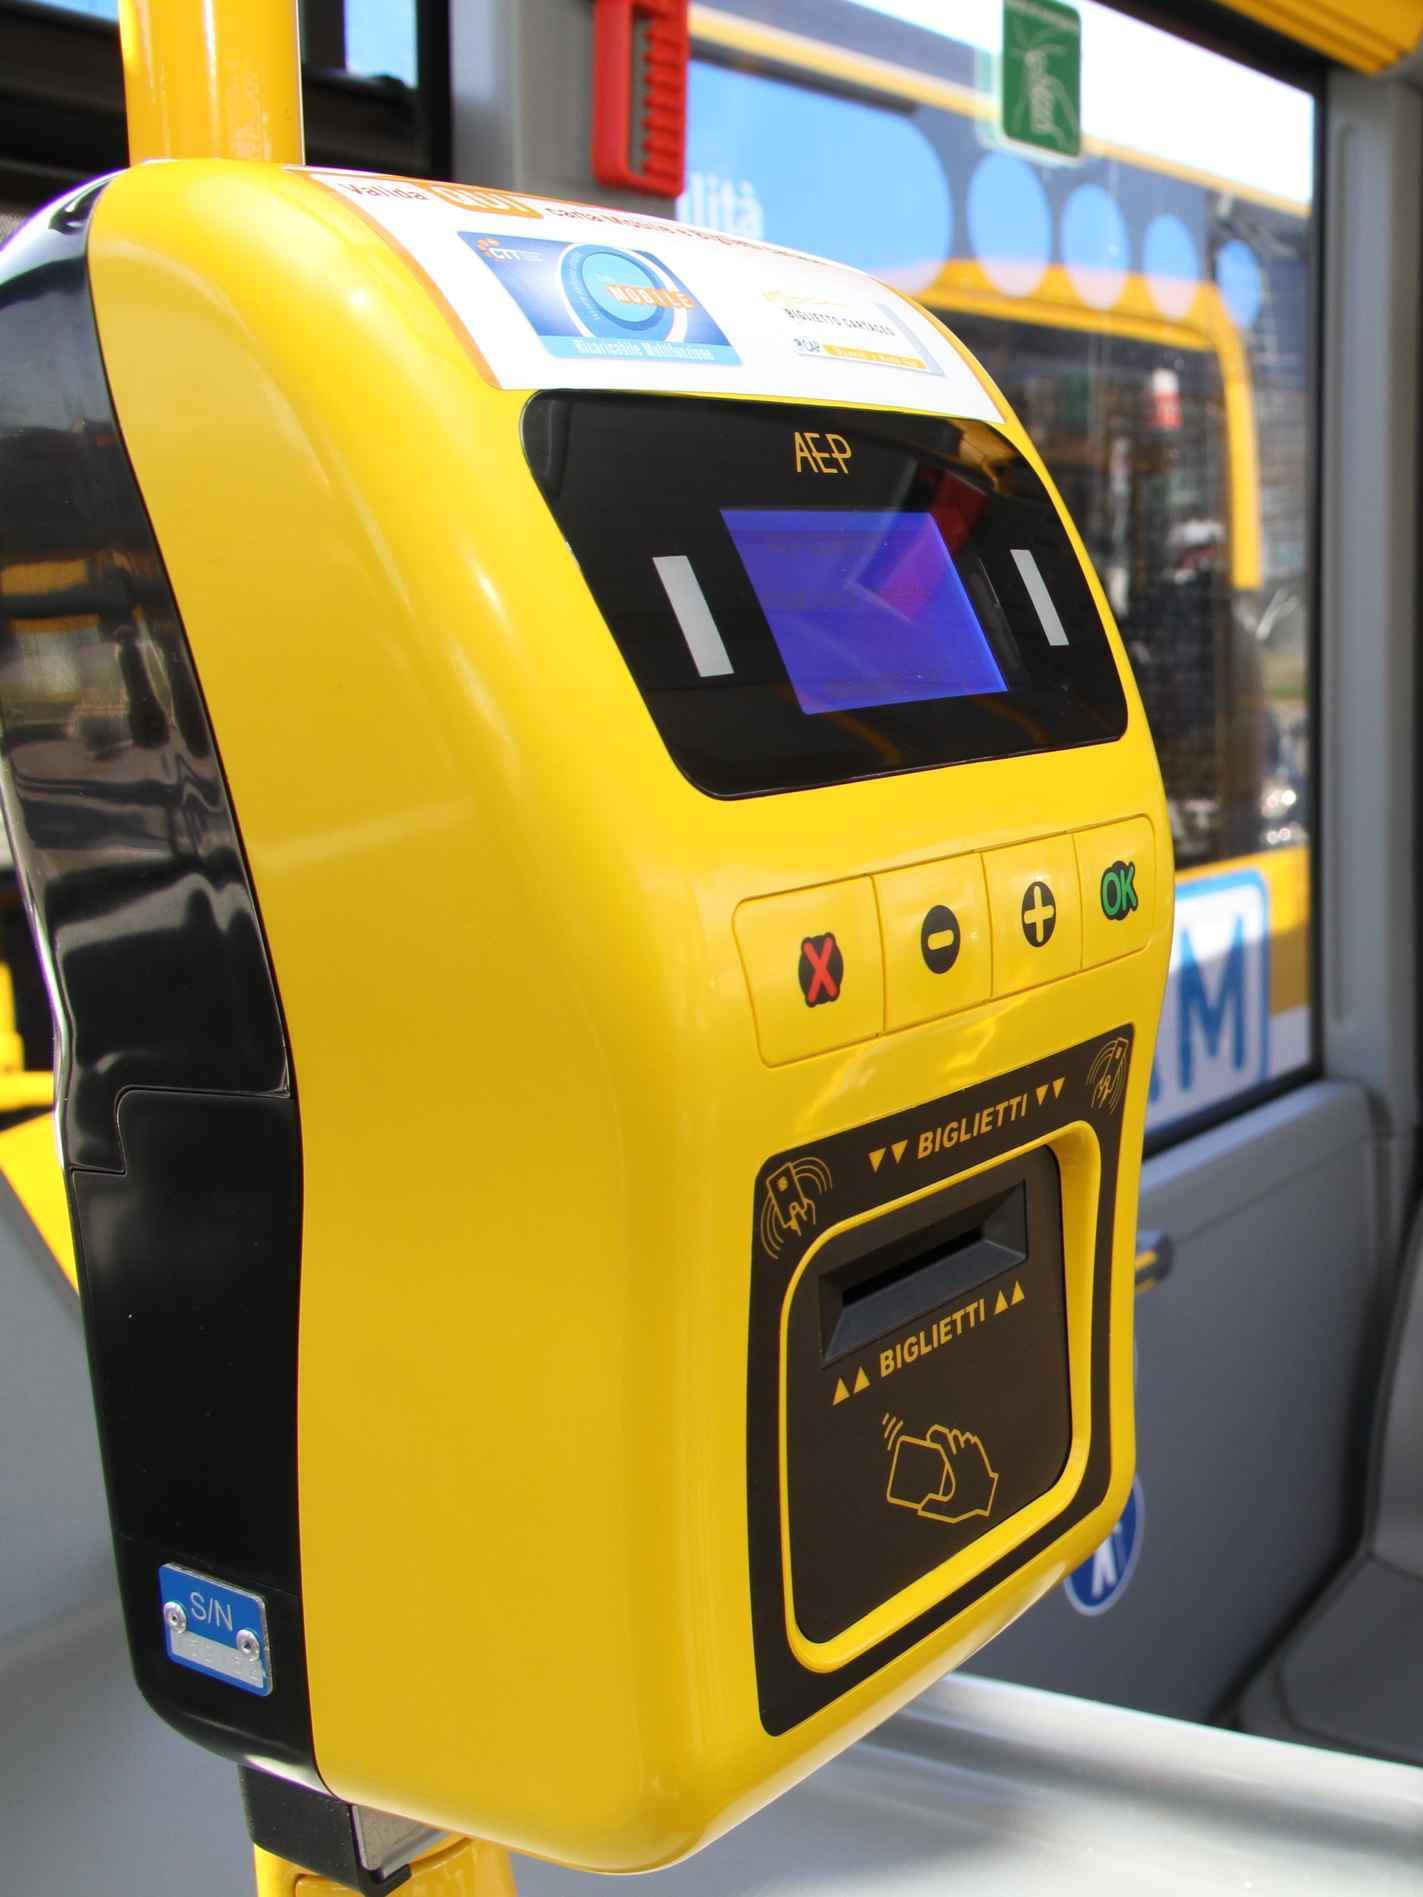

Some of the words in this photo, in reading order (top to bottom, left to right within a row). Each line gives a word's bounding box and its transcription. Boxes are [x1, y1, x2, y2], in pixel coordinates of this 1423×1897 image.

[794, 431, 852, 474] AEP
[1102, 864, 1138, 916] OK
[916, 1093, 1028, 1160] BIGLIETTI
[879, 1298, 986, 1378] BIGLIETTI
[190, 1591, 234, 1632] S/N
